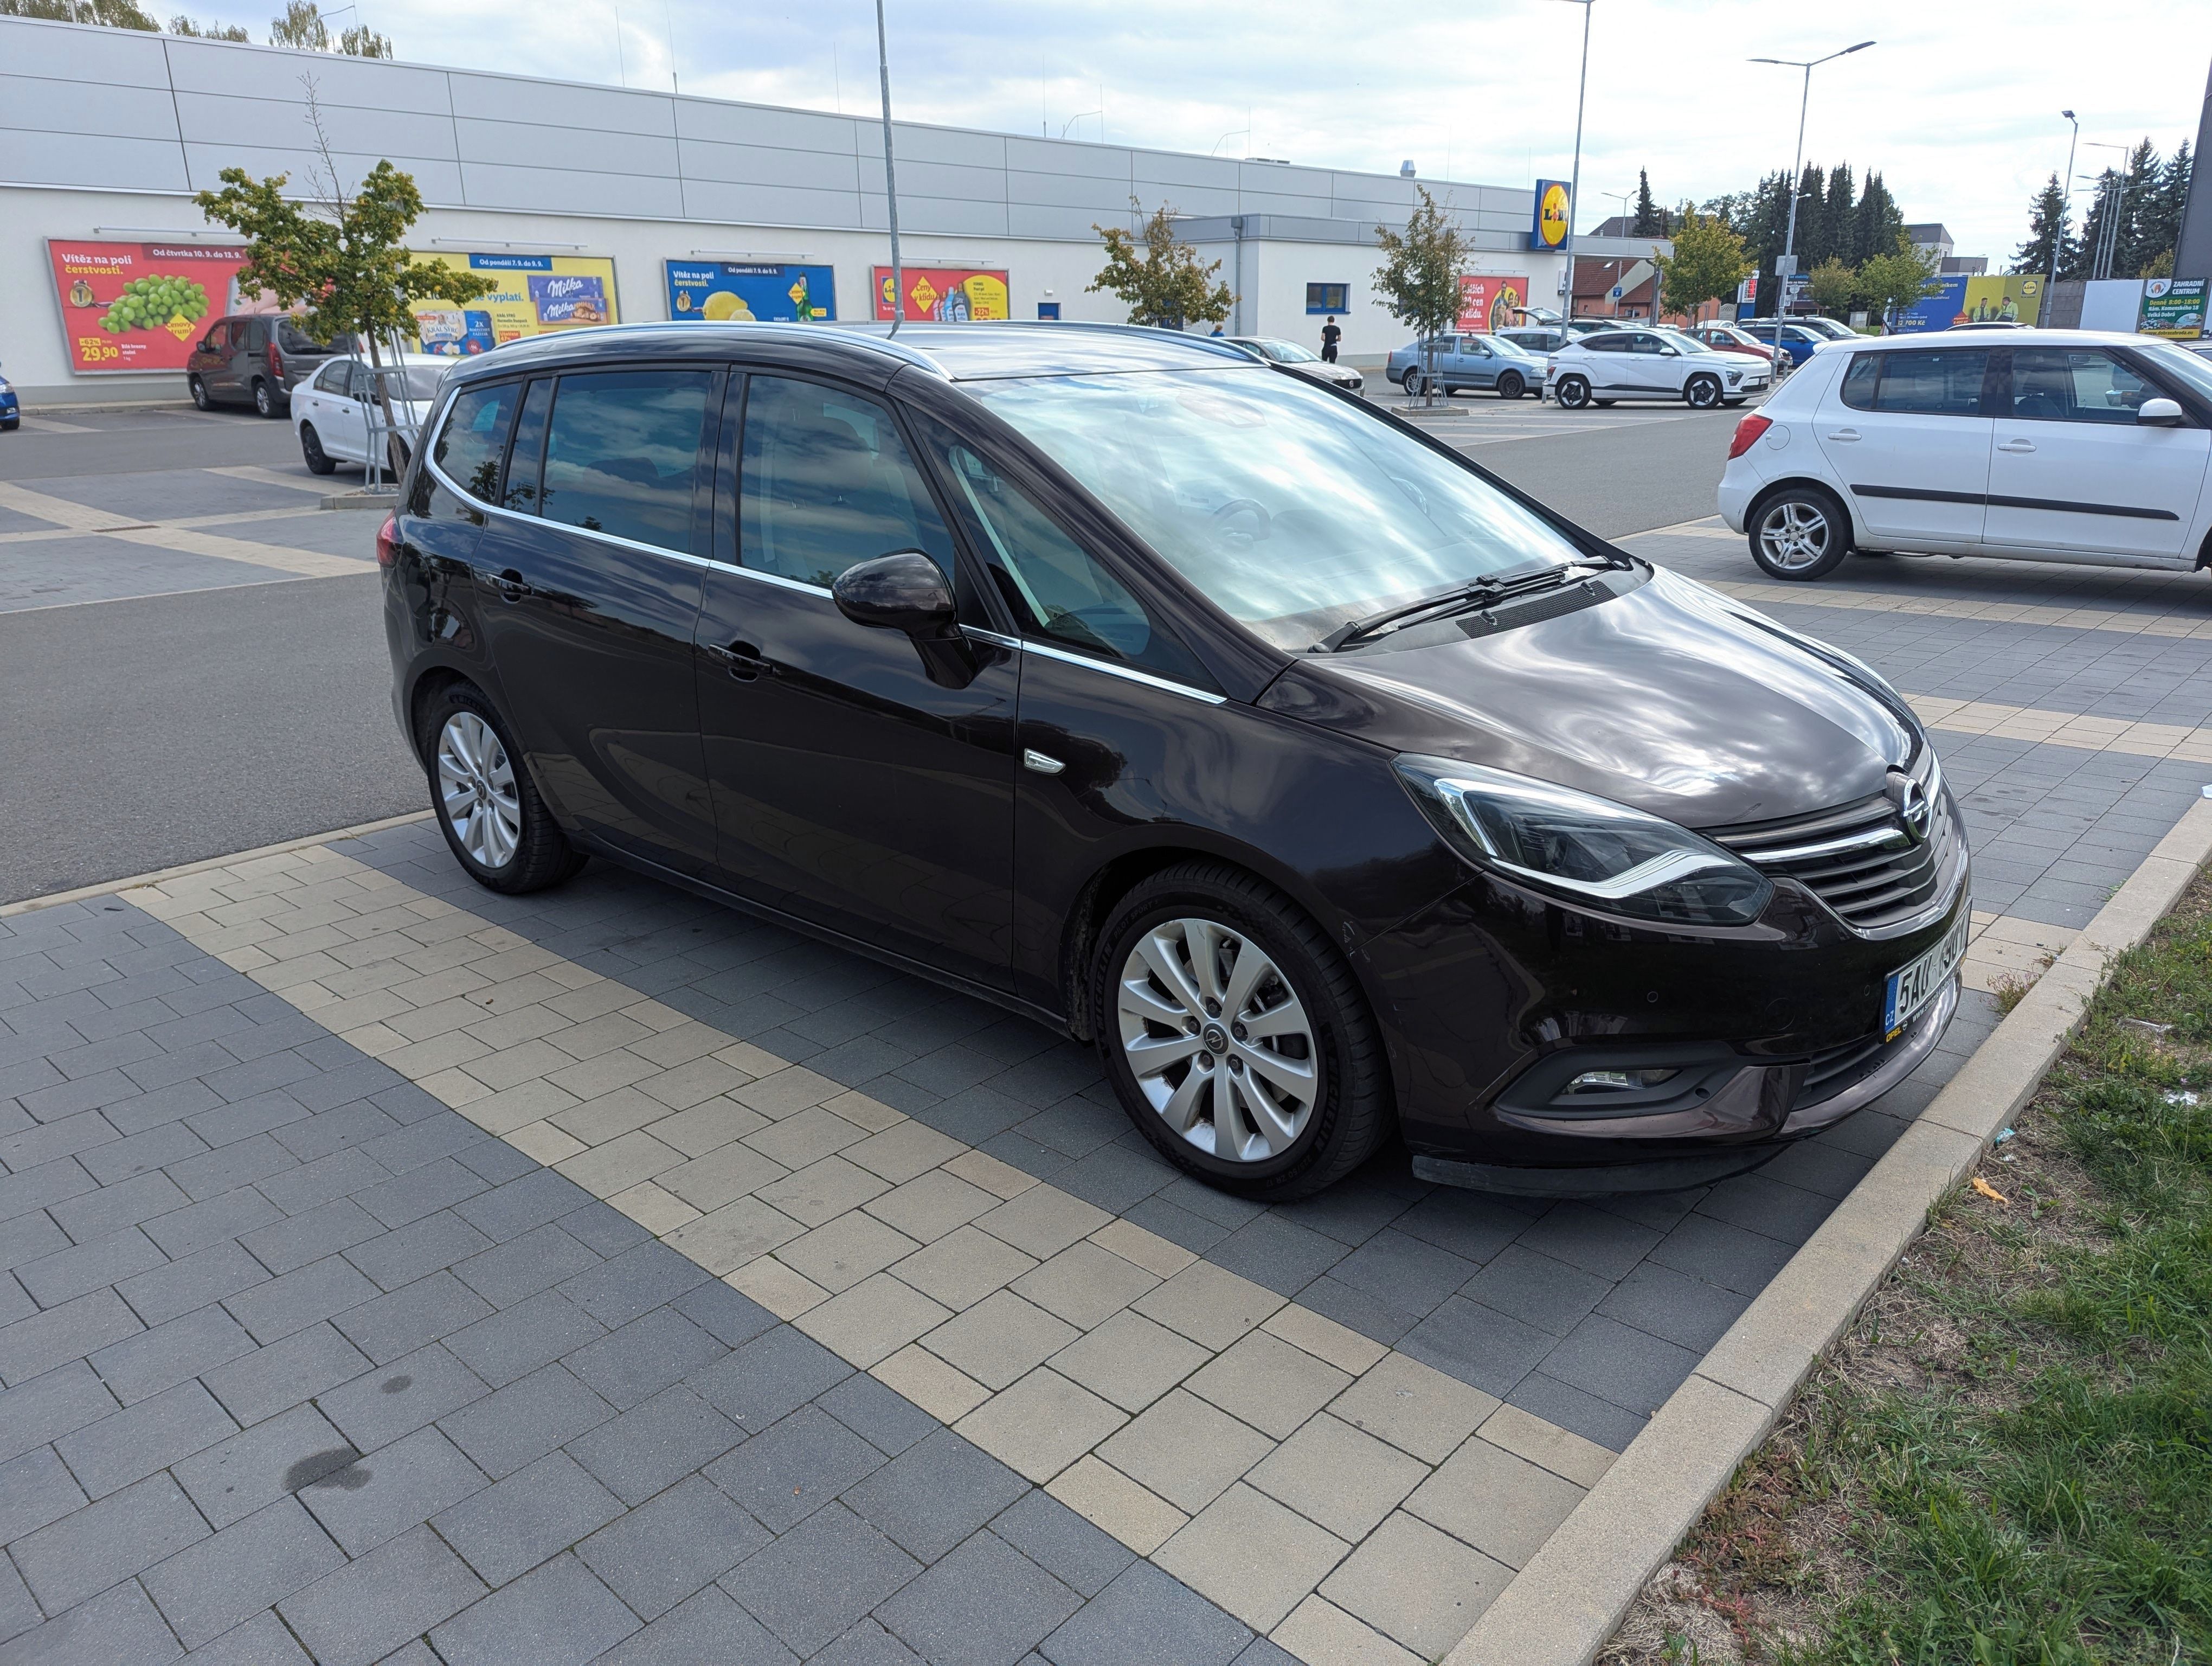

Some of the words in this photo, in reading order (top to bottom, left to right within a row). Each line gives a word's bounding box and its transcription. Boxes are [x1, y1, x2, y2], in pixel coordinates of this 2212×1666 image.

[62, 253, 92, 263] Vítěz
[94, 256, 108, 264] na
[110, 255, 132, 266] poli
[65, 265, 124, 274] čerstvosti.
[702, 271, 713, 280] poli
[548, 277, 583, 297] Milka
[916, 284, 931, 292] Ceny
[2173, 279, 2205, 287] ZAHRADNÍ
[486, 292, 524, 304] vyplatí.
[919, 293, 935, 301] klidu
[1472, 298, 1484, 306] cen
[547, 302, 576, 317] Milka
[1465, 307, 1483, 319] klidu.
[167, 320, 191, 329] Cenový
[81, 347, 118, 361] 29.90
[1114, 917, 1129, 939] PILOT
[1131, 901, 1153, 919] SPORT
[1095, 943, 1113, 1031] MICHELIN
[1899, 953, 1933, 1015] 5AU
[1885, 1009, 1894, 1026] CZ
[1886, 1026, 1902, 1043] OPEL
[1314, 1055, 1340, 1153] MICHELIN
